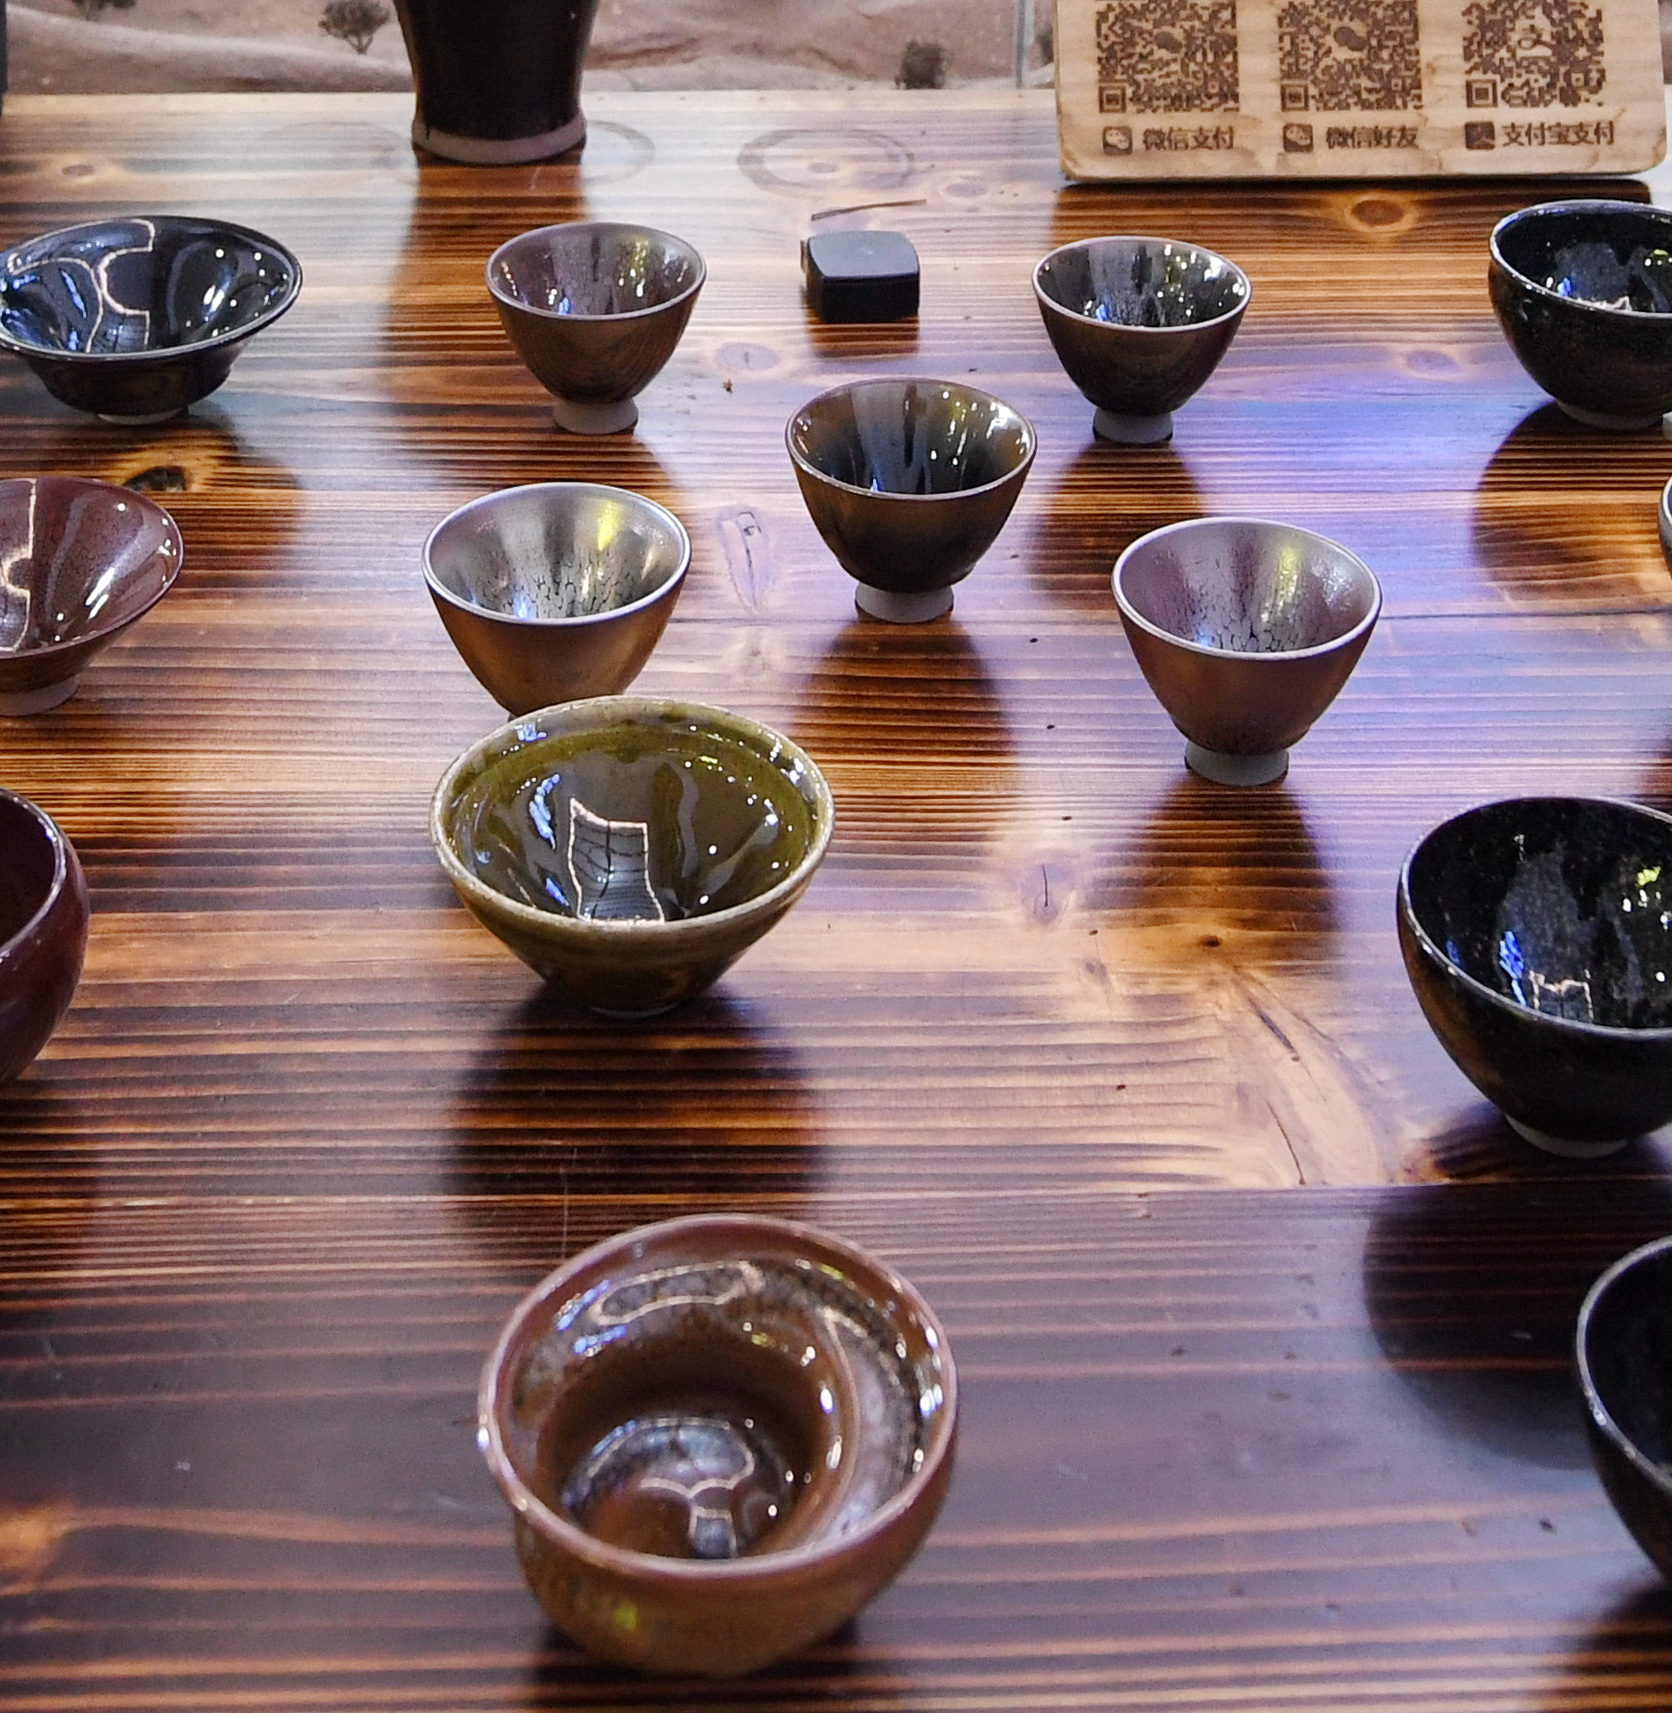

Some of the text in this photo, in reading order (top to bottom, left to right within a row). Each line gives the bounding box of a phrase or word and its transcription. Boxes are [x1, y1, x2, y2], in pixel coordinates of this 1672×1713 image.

[1142, 126, 1234, 151] 微信支付
[1325, 125, 1420, 149] 微信好友
[1501, 120, 1615, 147] 支付宝支付
